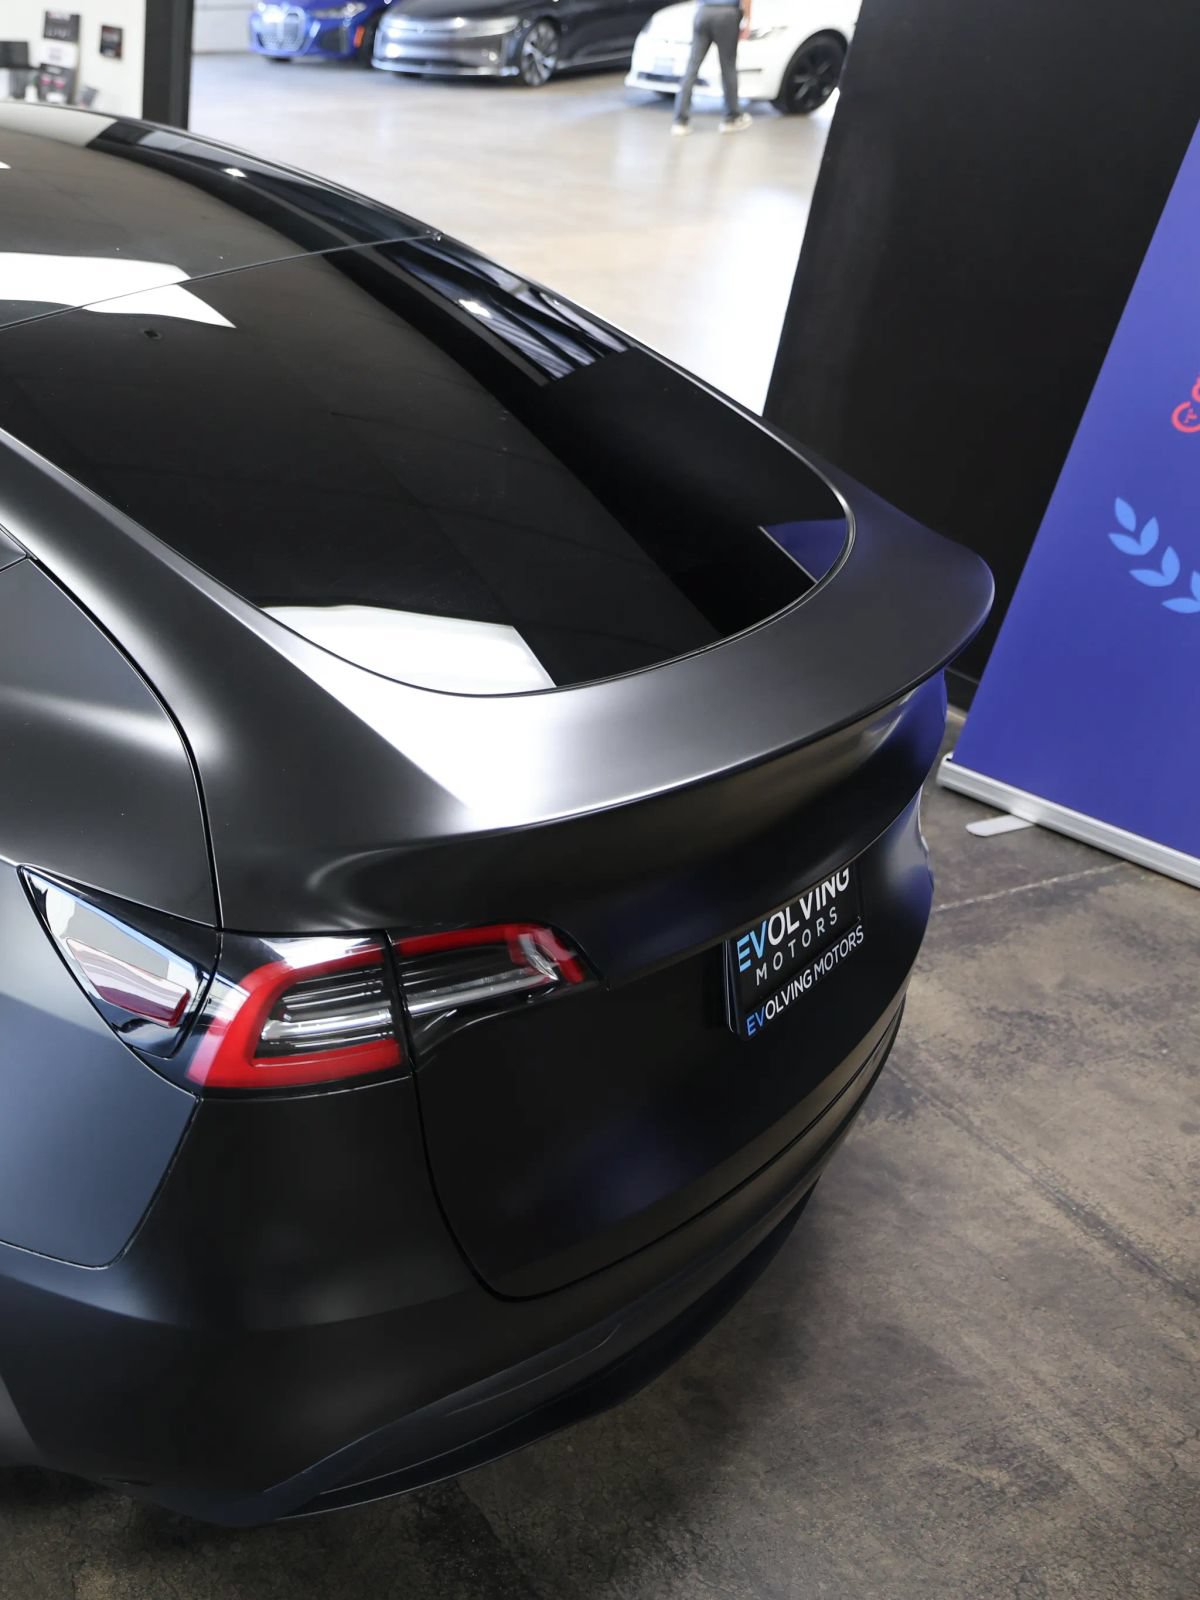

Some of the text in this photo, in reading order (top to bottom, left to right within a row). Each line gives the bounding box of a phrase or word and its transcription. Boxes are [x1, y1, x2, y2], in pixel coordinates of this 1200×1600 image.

[736, 867, 850, 972] EVOLVING
[755, 906, 838, 985] MOTORS
[746, 924, 865, 1037] EVOLVING MOTORS
